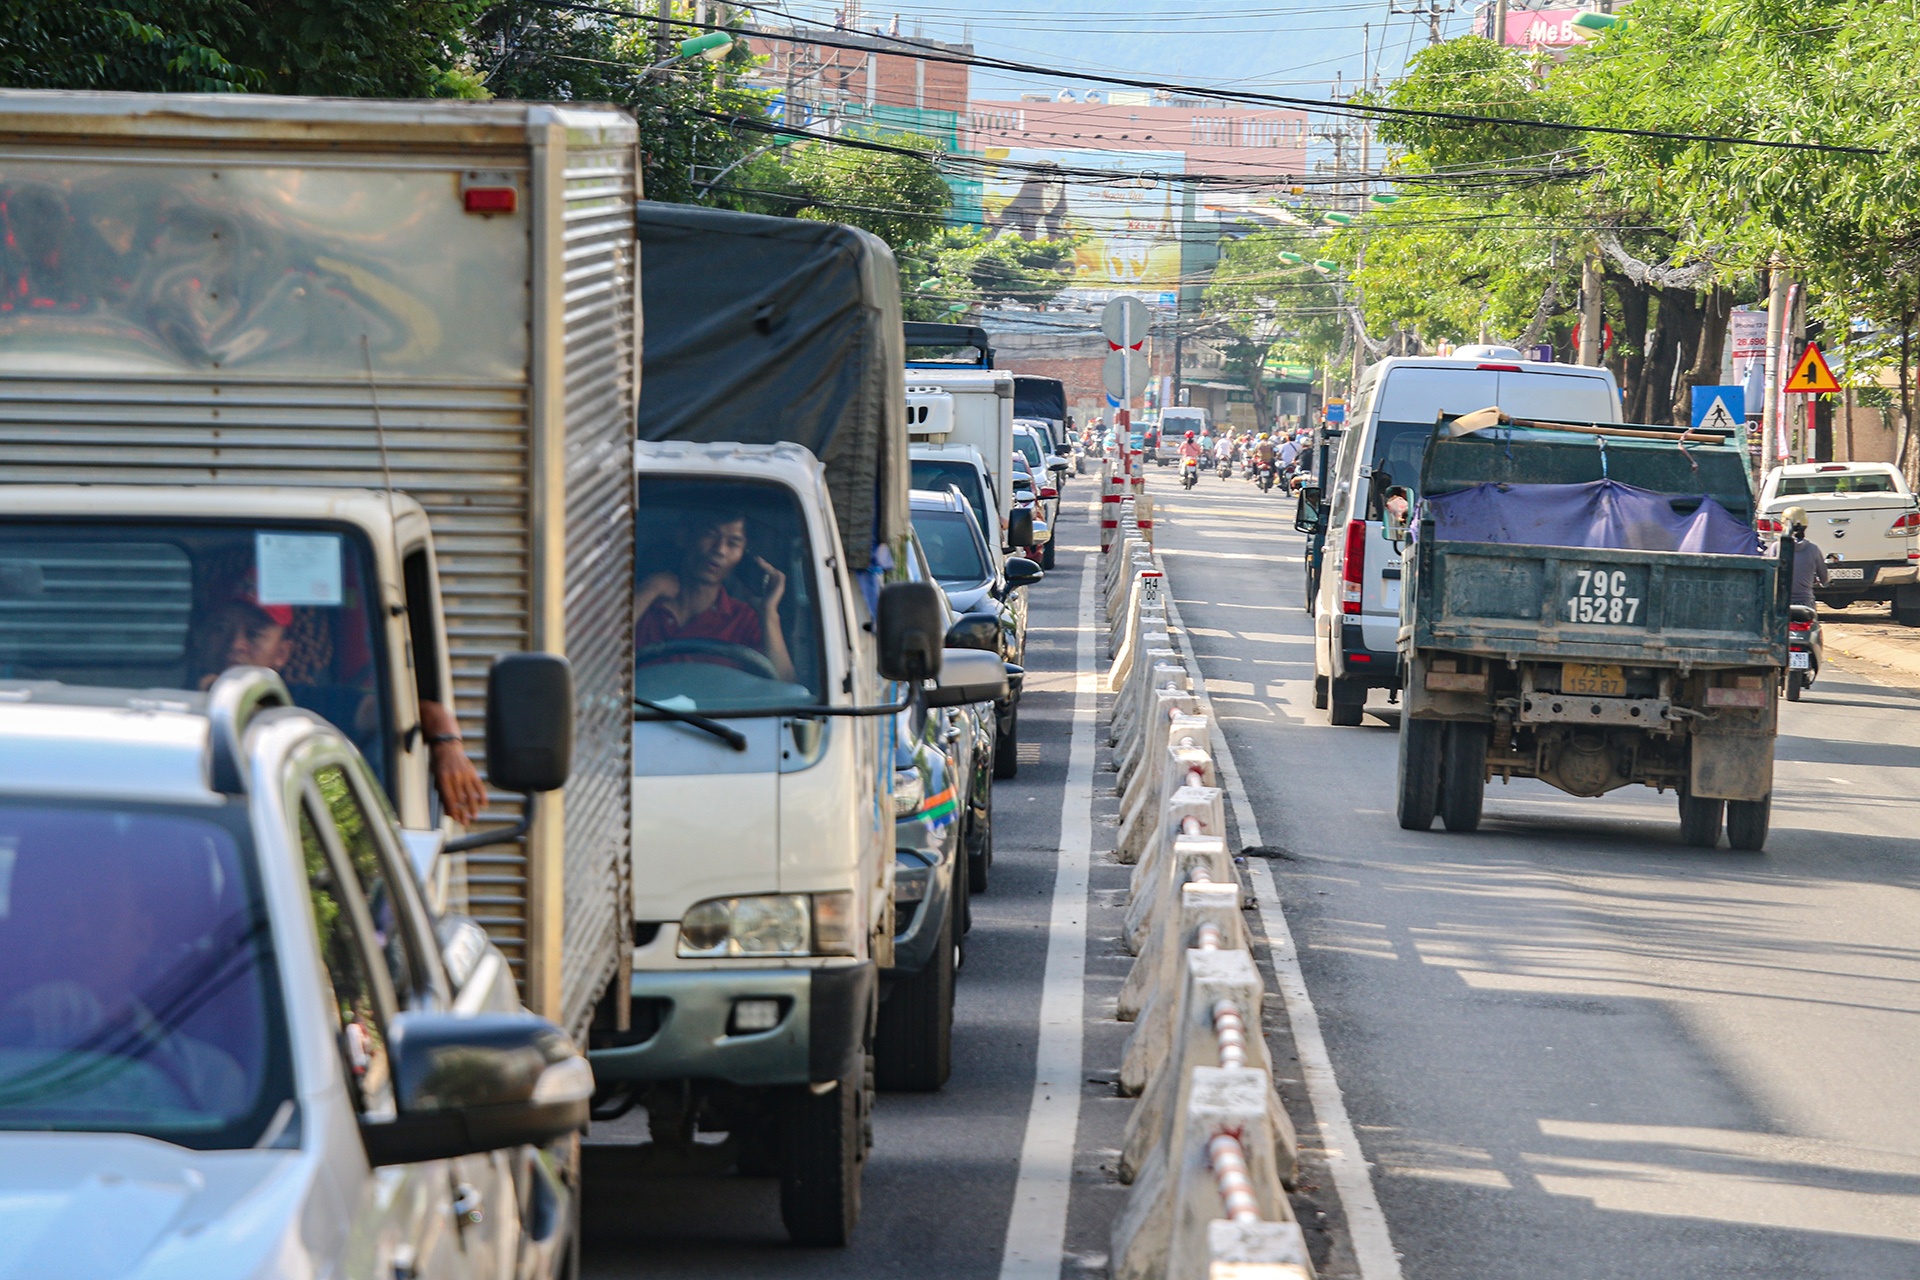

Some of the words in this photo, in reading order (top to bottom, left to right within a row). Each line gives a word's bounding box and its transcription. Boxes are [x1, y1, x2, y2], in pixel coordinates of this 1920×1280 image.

[1144, 578, 1158, 590] H4
[1577, 570, 1627, 597] 79C
[1567, 596, 1640, 623] 15287
